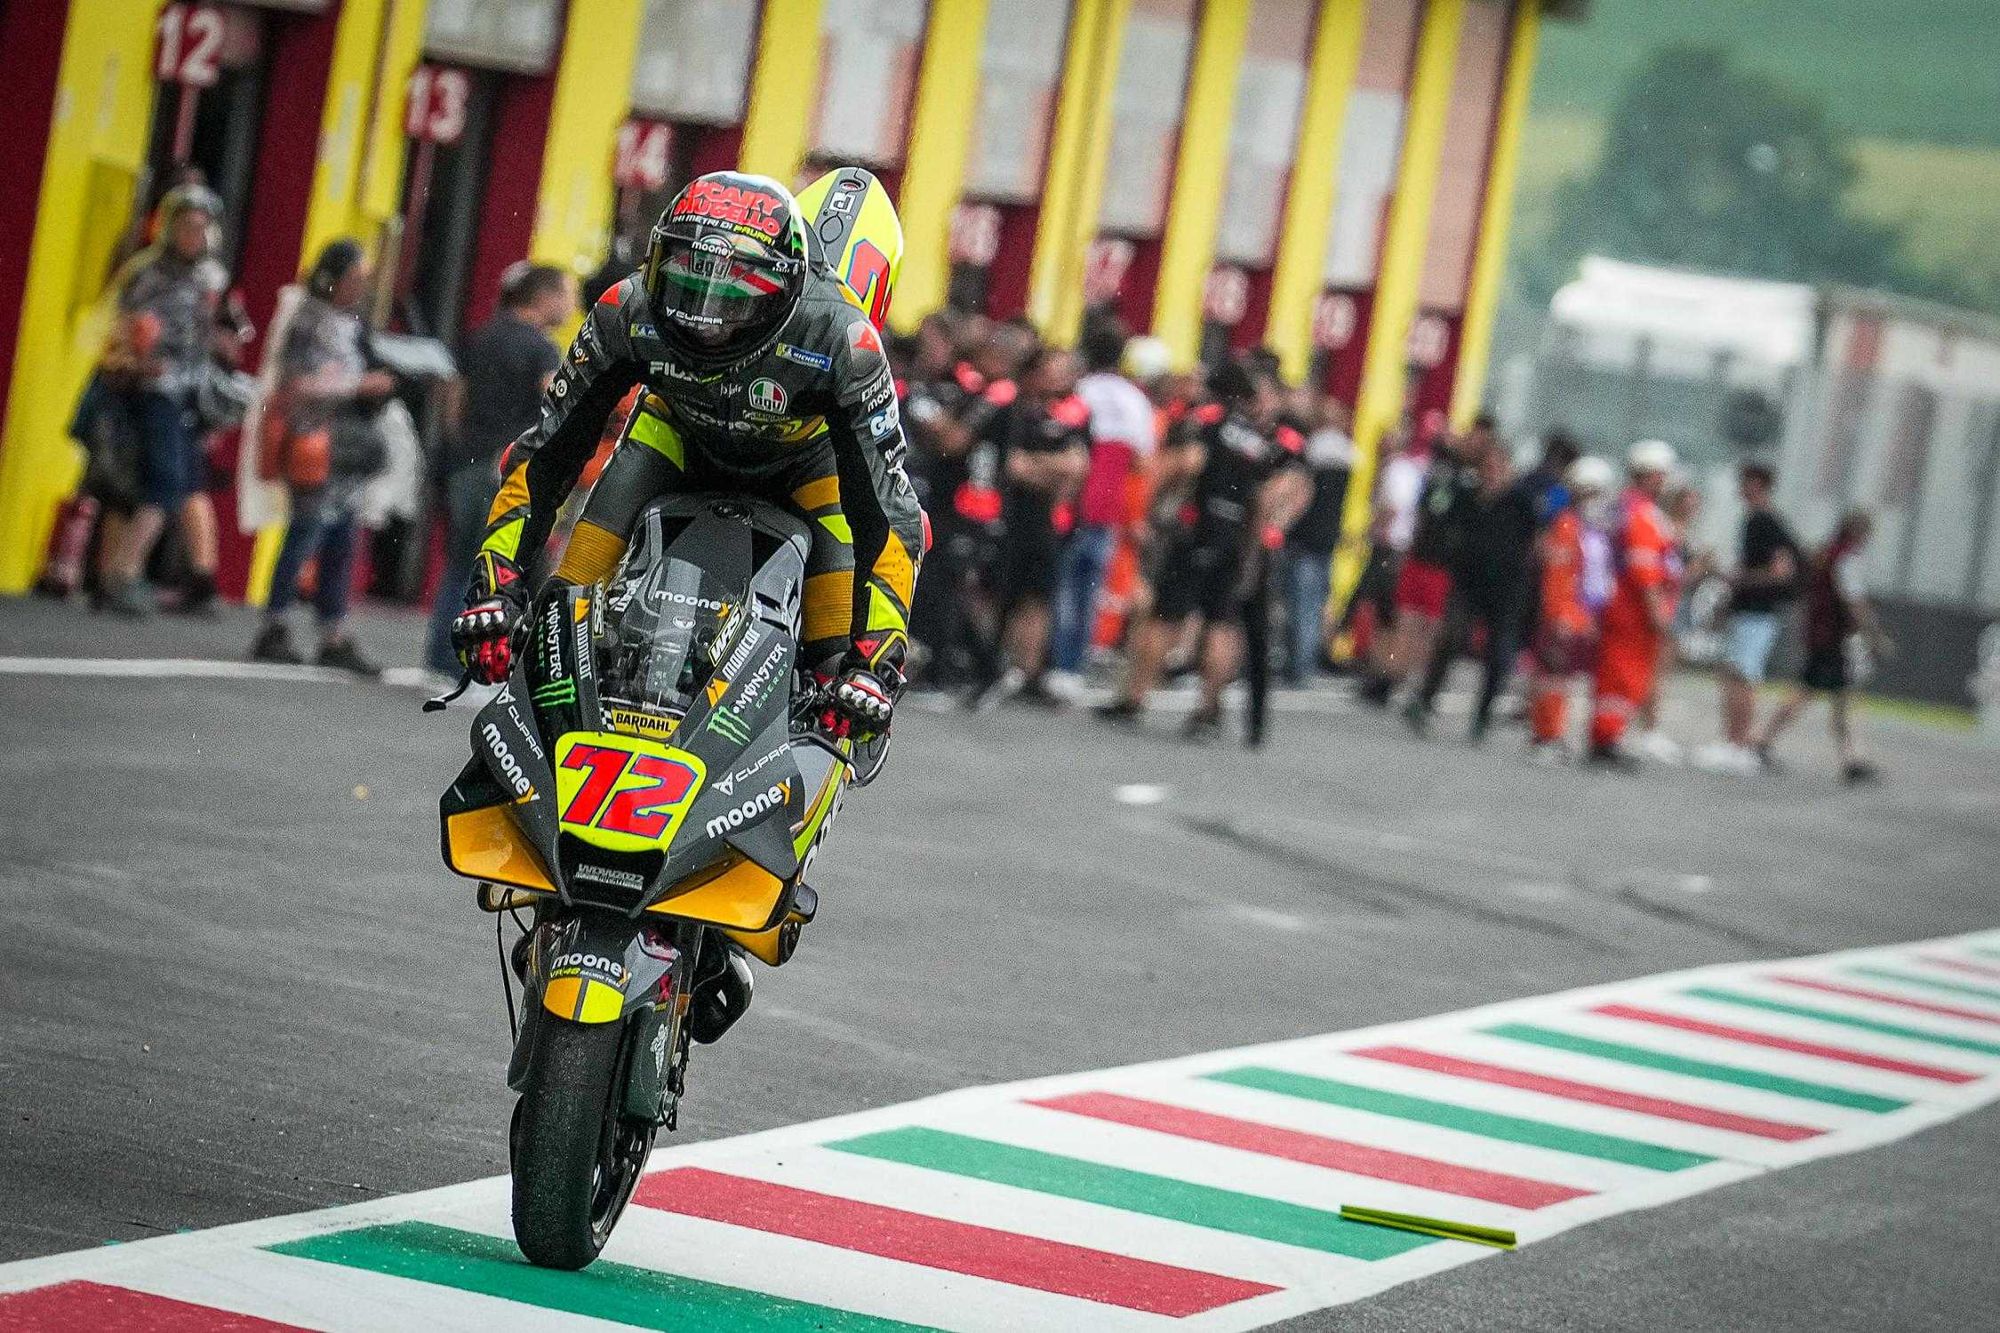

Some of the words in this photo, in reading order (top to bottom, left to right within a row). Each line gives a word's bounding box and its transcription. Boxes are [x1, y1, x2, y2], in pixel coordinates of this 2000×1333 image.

[157, 4, 224, 86] 12
[405, 68, 469, 141] 13
[614, 124, 670, 187] 14
[674, 197, 780, 237] MUGELLO
[691, 240, 735, 259] mooney
[655, 590, 732, 618] mooney
[547, 600, 562, 680] MONSTER
[710, 605, 742, 662] WRS
[735, 642, 788, 710] MONSTER
[754, 660, 789, 709] ENERGY
[508, 705, 544, 760] CUPRA
[616, 713, 672, 733] BARDAHL
[482, 722, 540, 805] mooney
[735, 742, 791, 782] CUPRA
[559, 743, 698, 839] 72
[705, 777, 792, 838] mooney
[551, 952, 633, 986] mooney
